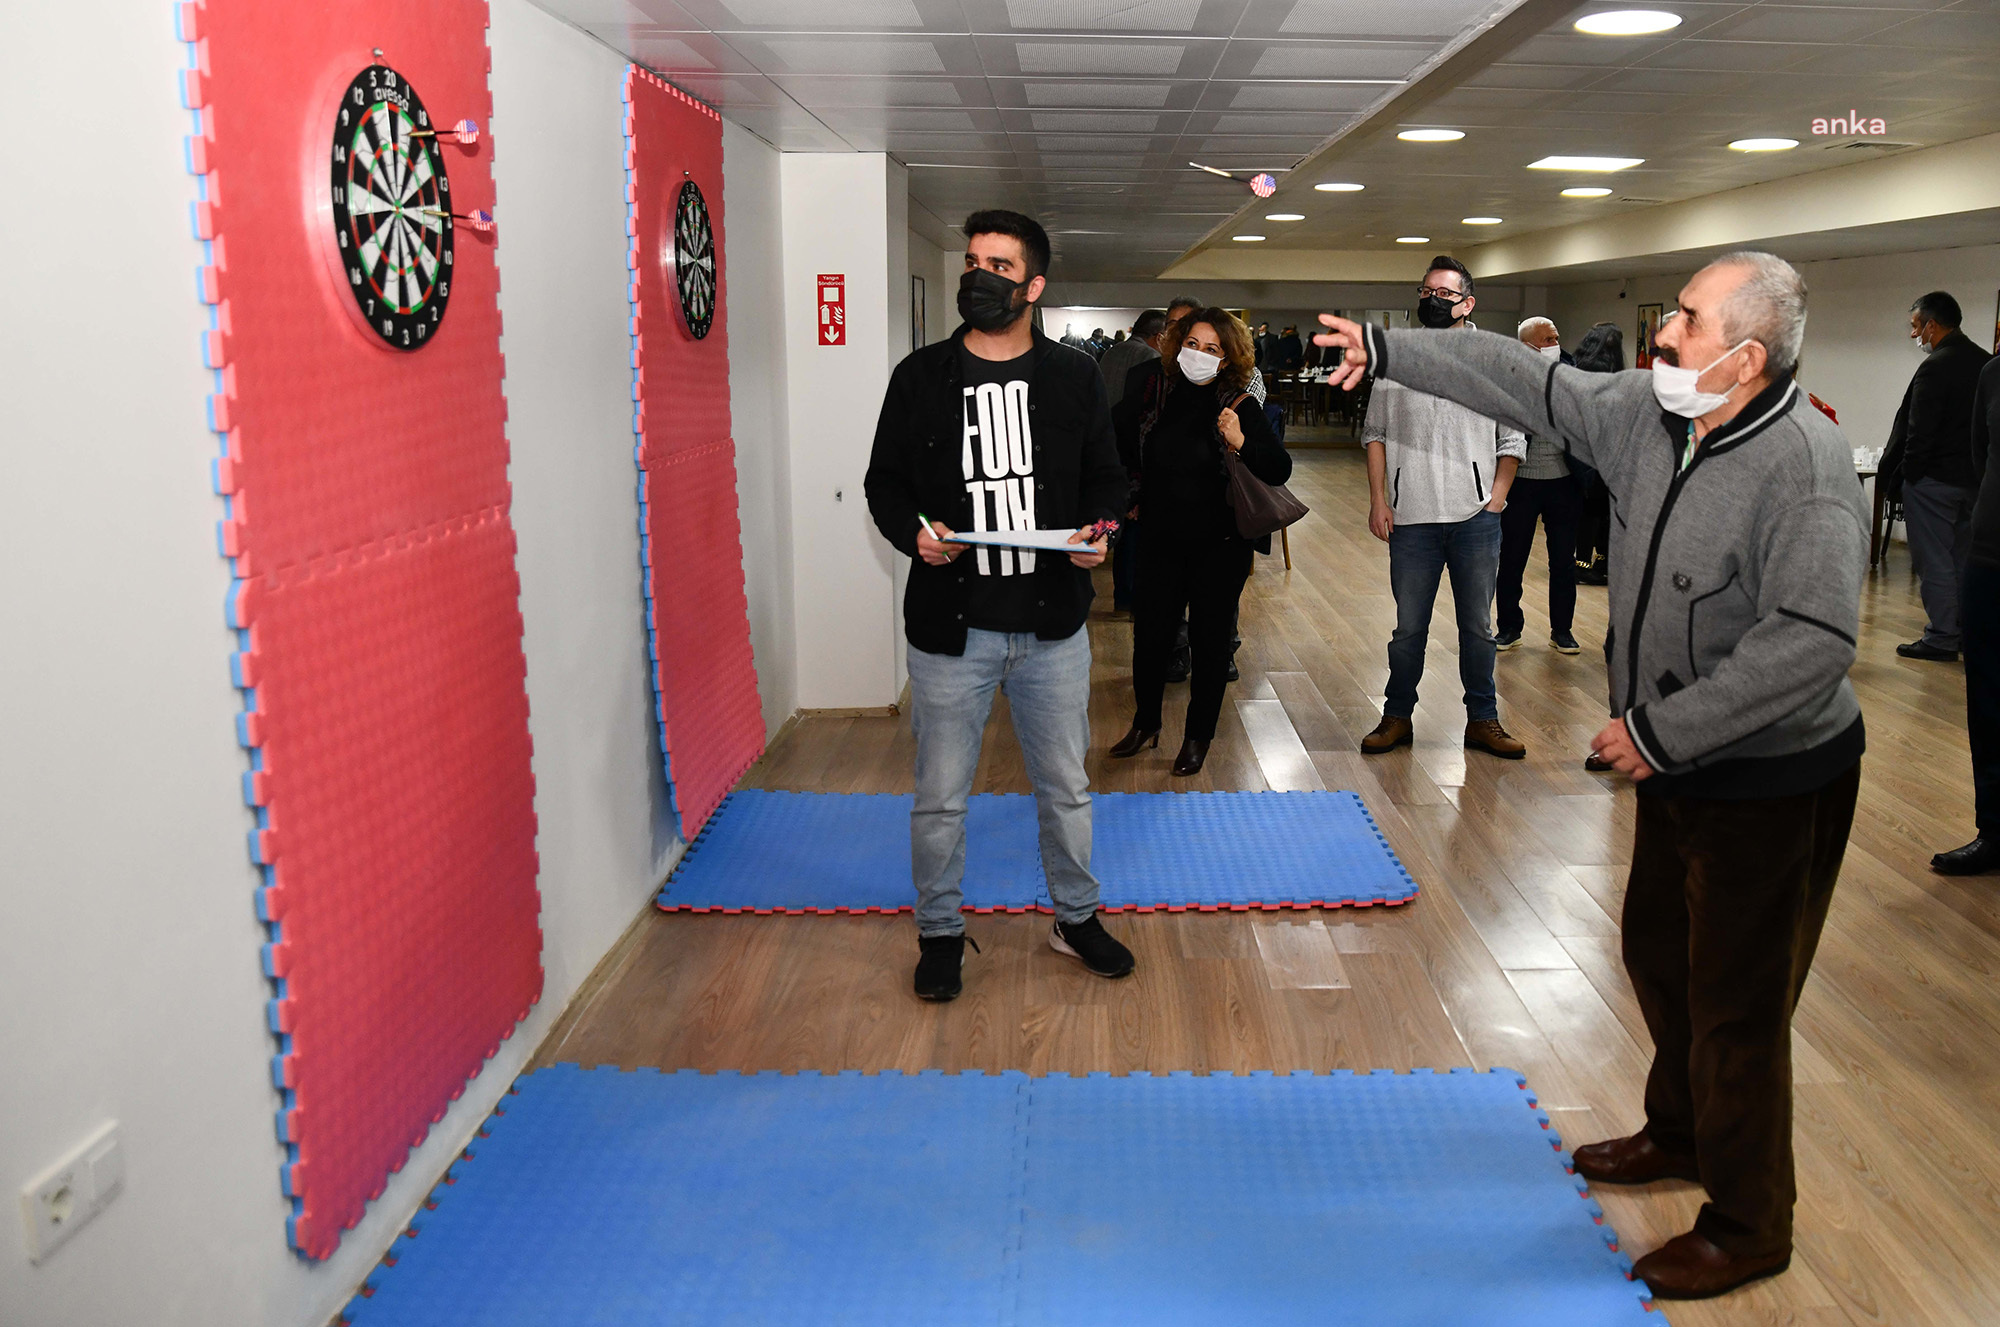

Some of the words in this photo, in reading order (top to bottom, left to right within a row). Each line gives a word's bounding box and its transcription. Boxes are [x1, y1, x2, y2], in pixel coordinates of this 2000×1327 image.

[369, 70, 377, 87] 5
[384, 69, 396, 87] 20
[353, 87, 364, 106] 12
[405, 84, 410, 99] 1
[341, 108, 349, 127] 9
[418, 109, 428, 127] 18
[334, 144, 345, 164] 14
[433, 141, 439, 156] 4
[439, 176, 449, 192] 13
[333, 185, 343, 205] 11
[339, 229, 348, 248] 8
[444, 250, 453, 265] 10
[351, 267, 362, 285] 16
[439, 281, 448, 297] 15
[367, 299, 375, 316] 7
[431, 306, 438, 322] 2
[383, 319, 393, 337] 19
[402, 328, 410, 345] 3
[416, 323, 426, 339] 17
